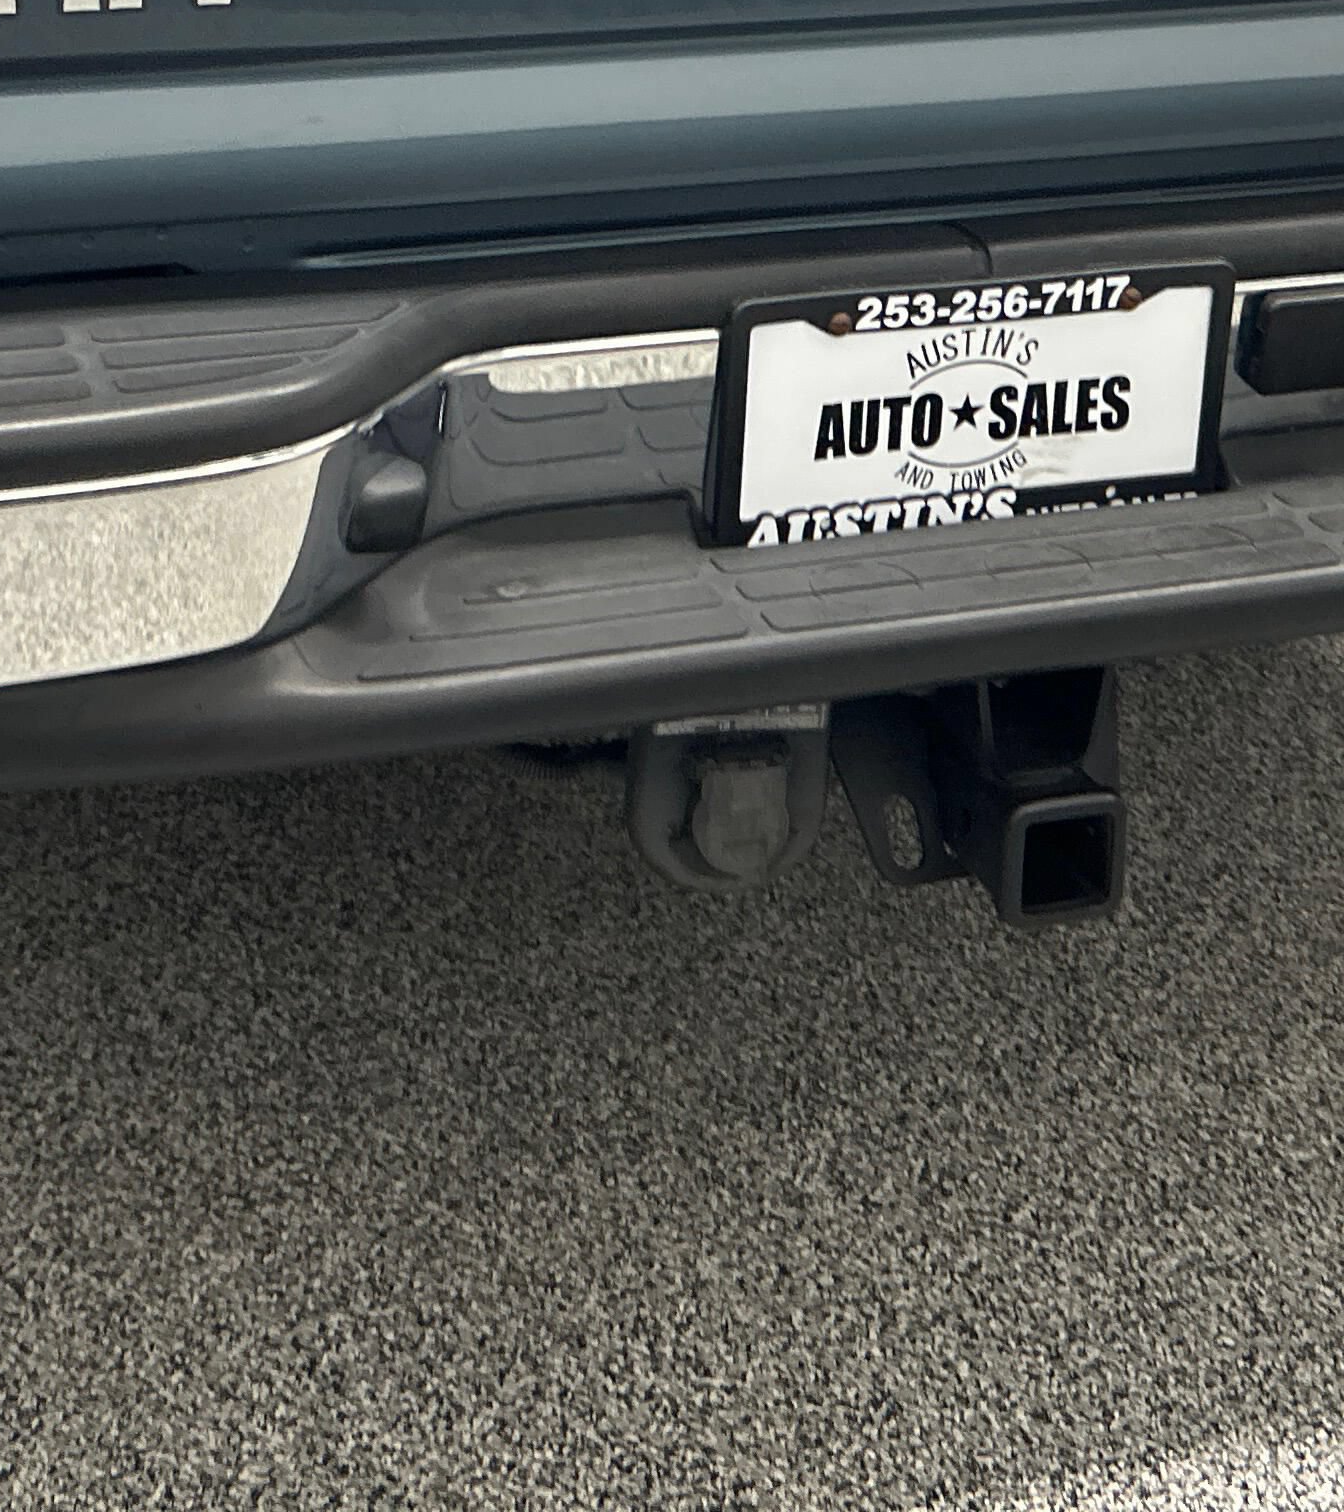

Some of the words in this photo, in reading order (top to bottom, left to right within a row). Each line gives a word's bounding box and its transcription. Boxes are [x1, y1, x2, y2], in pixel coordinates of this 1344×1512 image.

[855, 274, 1131, 331] 253-256-7117
[906, 327, 1039, 378] AUSTIN'S
[814, 392, 944, 461] AUTO
[988, 375, 1132, 441] SALES
[893, 461, 935, 490] AND
[948, 448, 1028, 490] TOWING
